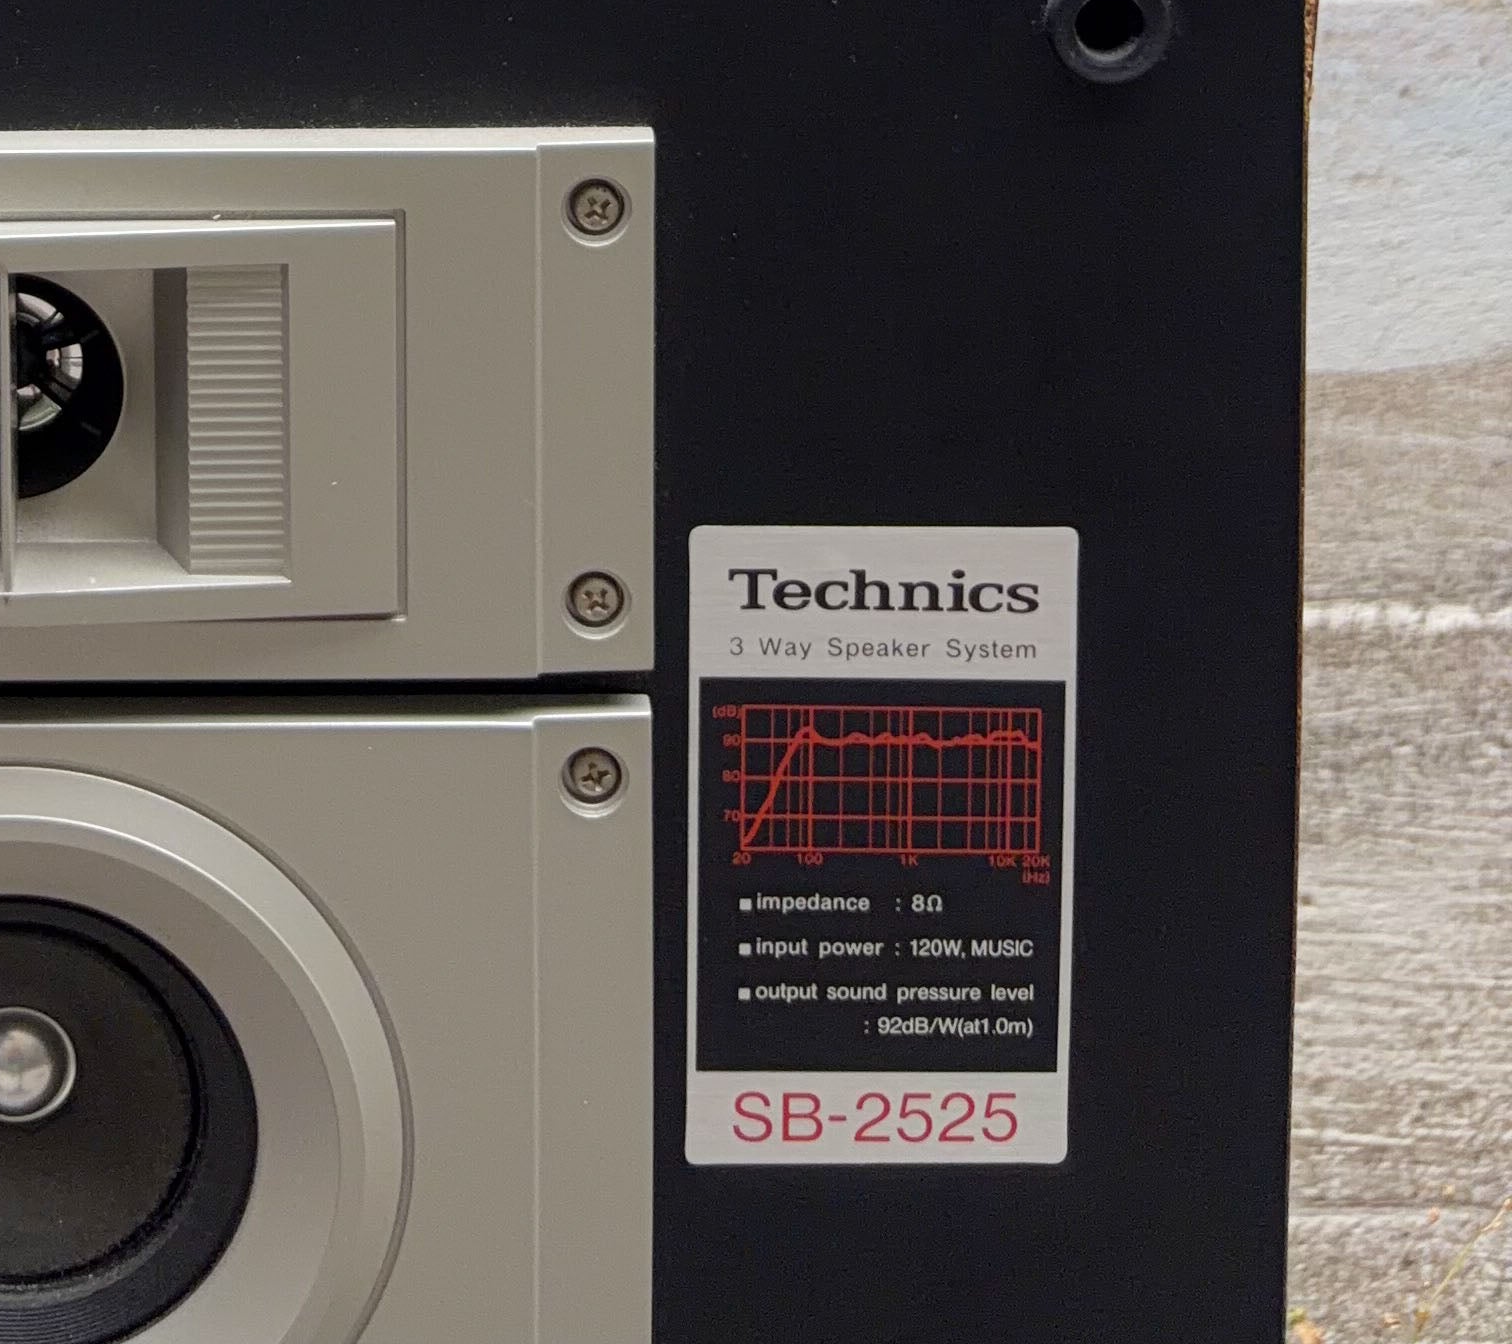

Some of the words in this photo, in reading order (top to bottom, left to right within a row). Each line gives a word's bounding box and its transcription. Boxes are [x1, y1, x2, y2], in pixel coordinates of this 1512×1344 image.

[728, 568, 1039, 613] Technics
[729, 637, 743, 656] 3
[759, 638, 812, 659] Way
[828, 638, 931, 661] Speaker
[946, 639, 1037, 661] System
[723, 810, 741, 822] 70
[733, 852, 752, 865] 20
[796, 852, 824, 866] 100
[901, 853, 918, 867] 1K
[989, 854, 1014, 867] 10K
[1022, 855, 1050, 868] 20K
[756, 893, 870, 913] impedance
[911, 895, 943, 912] 8Ω
[756, 939, 808, 957] input
[819, 942, 884, 957] power
[910, 939, 966, 959] 120W,
[971, 940, 1033, 957] MUSIC
[755, 984, 818, 1003] output
[827, 984, 887, 1001] sound
[897, 985, 982, 1003] pressure
[991, 985, 1034, 1001] level
[732, 1091, 1018, 1143] SB-2525
